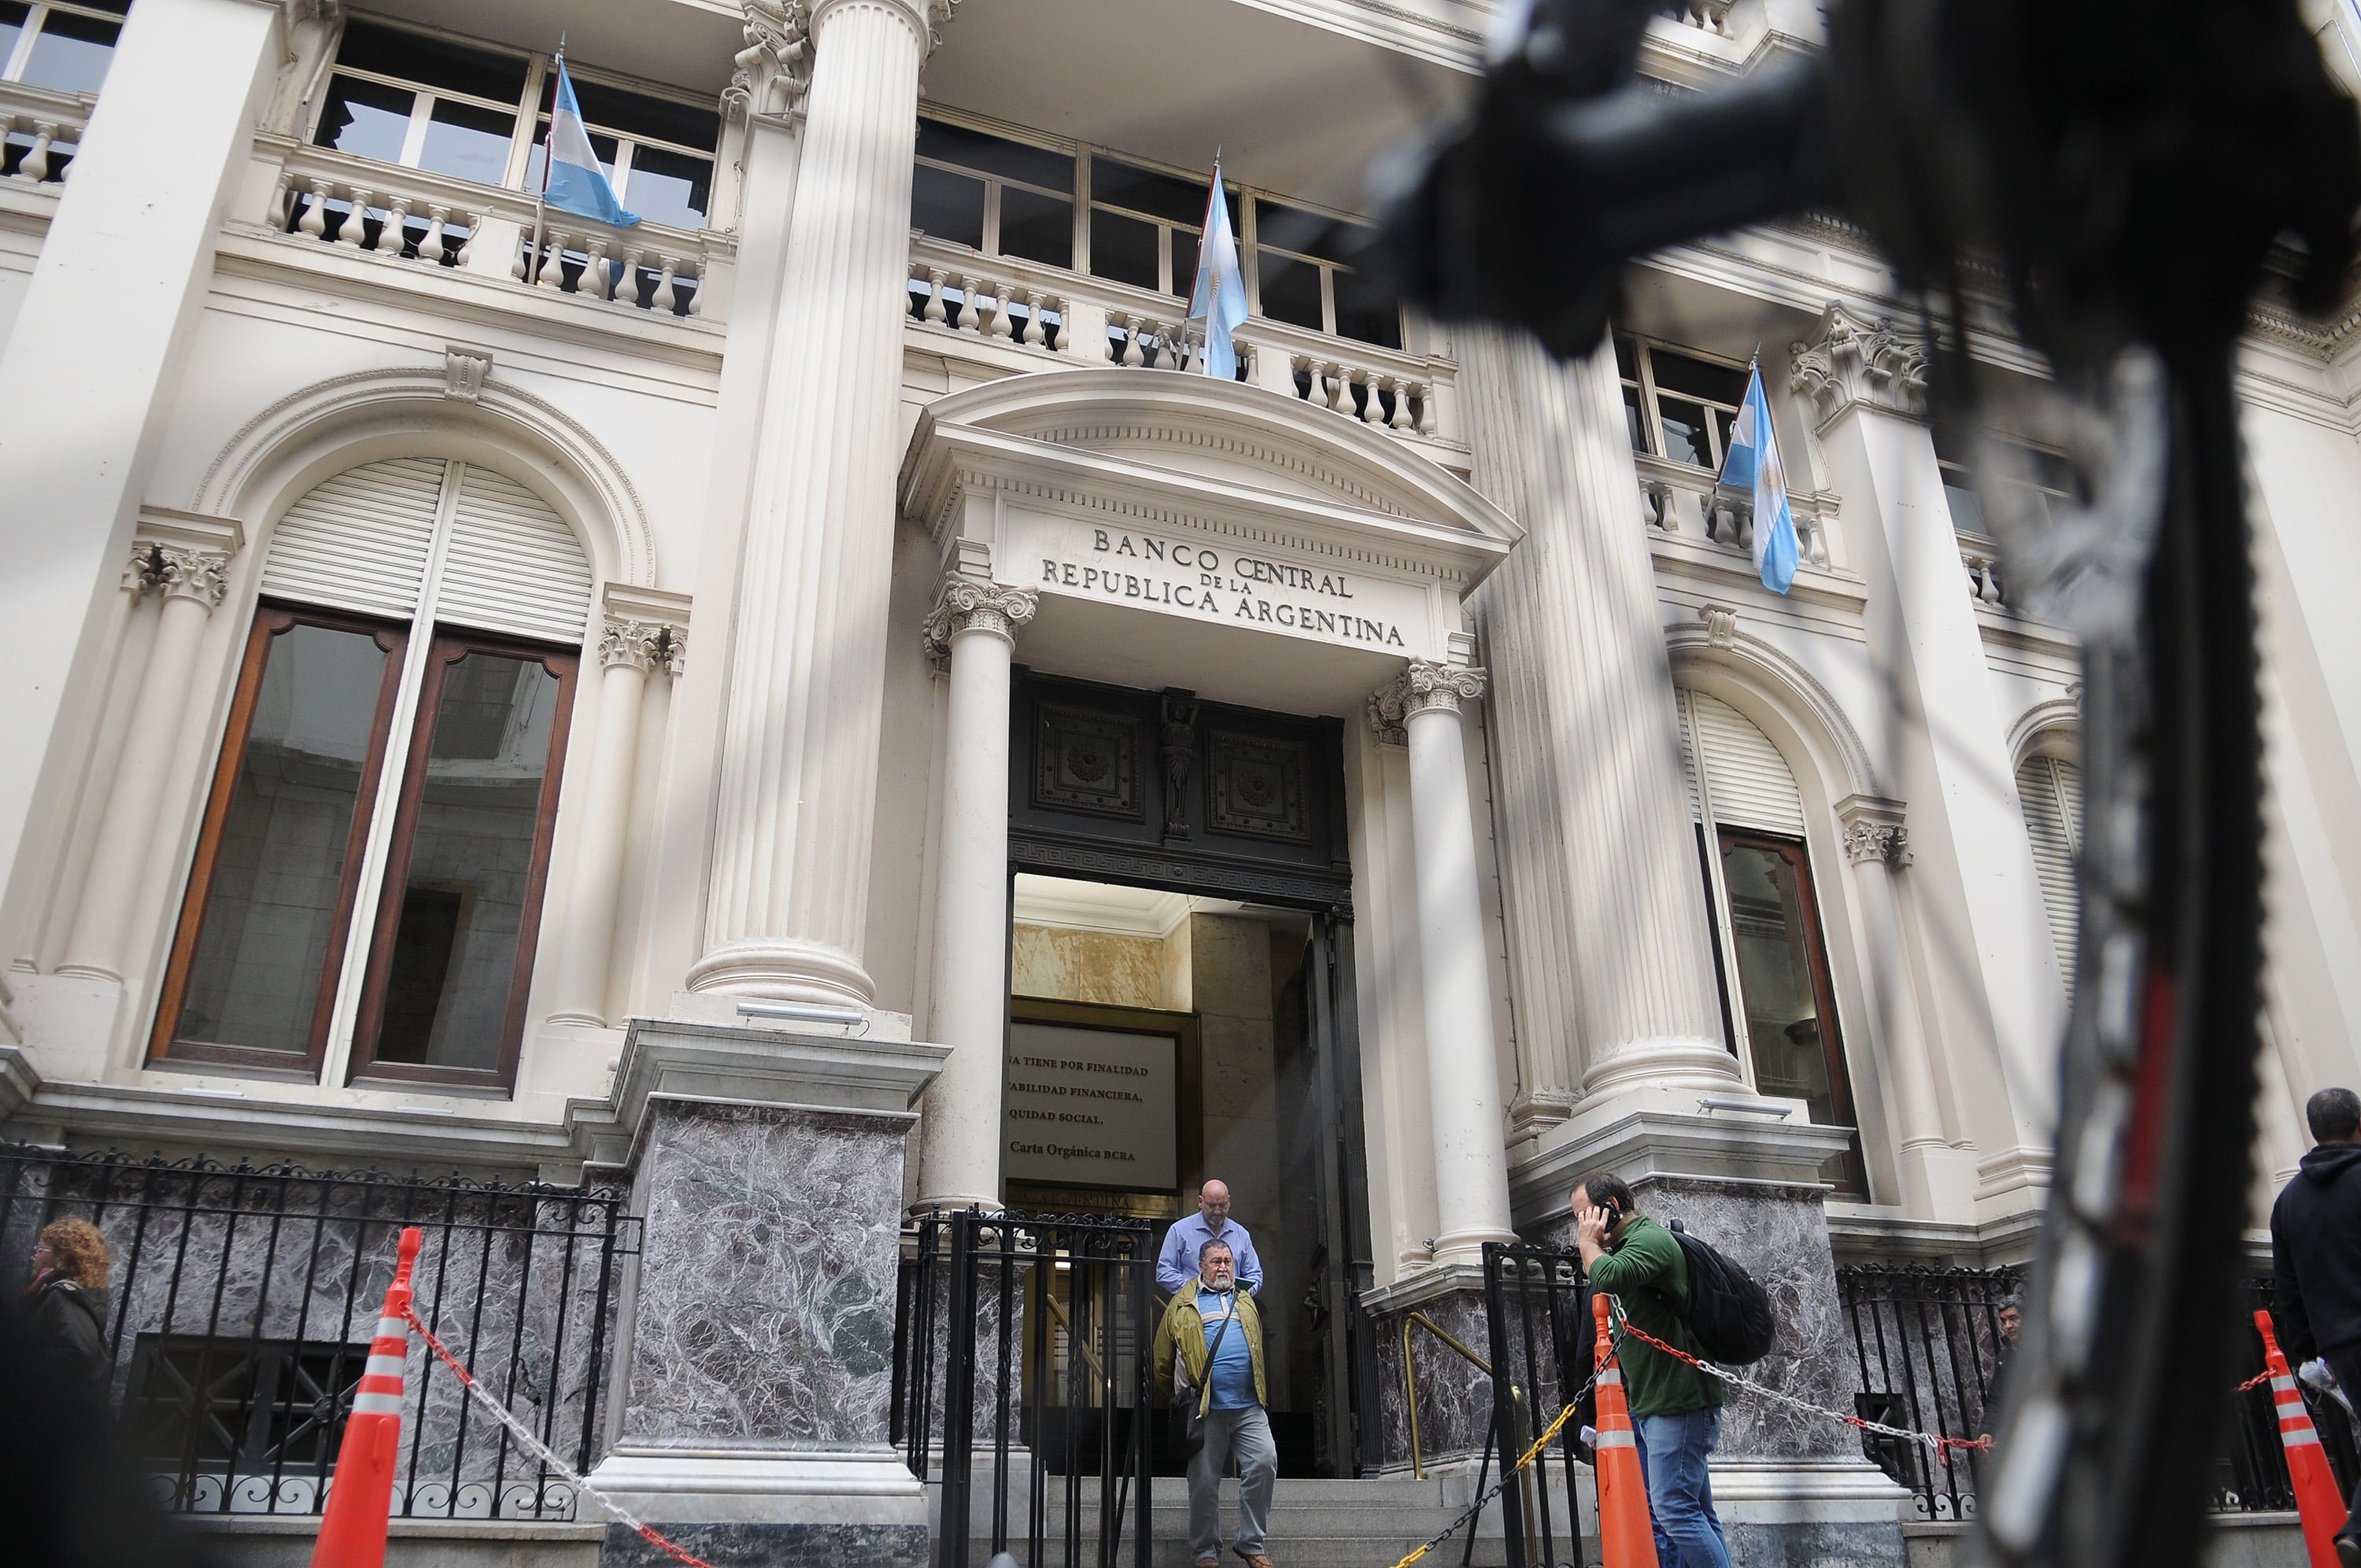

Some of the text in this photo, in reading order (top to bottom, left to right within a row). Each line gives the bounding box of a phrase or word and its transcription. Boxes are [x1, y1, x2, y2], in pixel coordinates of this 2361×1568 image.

[1093, 529, 1354, 598] BANCO CENTRAL
[1200, 573, 1252, 595] DE LA
[1042, 559, 1406, 647] REPUBLICA ARGENTINA
[1023, 1057, 1058, 1068] TIENE
[1060, 1061, 1084, 1071] POR
[1087, 1063, 1148, 1076] FINALIDAD
[1008, 1082, 1144, 1102] ABILIDAD FINANCIERA,
[1009, 1109, 1103, 1124] QUIDAD SOCIAL.
[1011, 1141, 1136, 1161] Carta Orgánica BCRA
